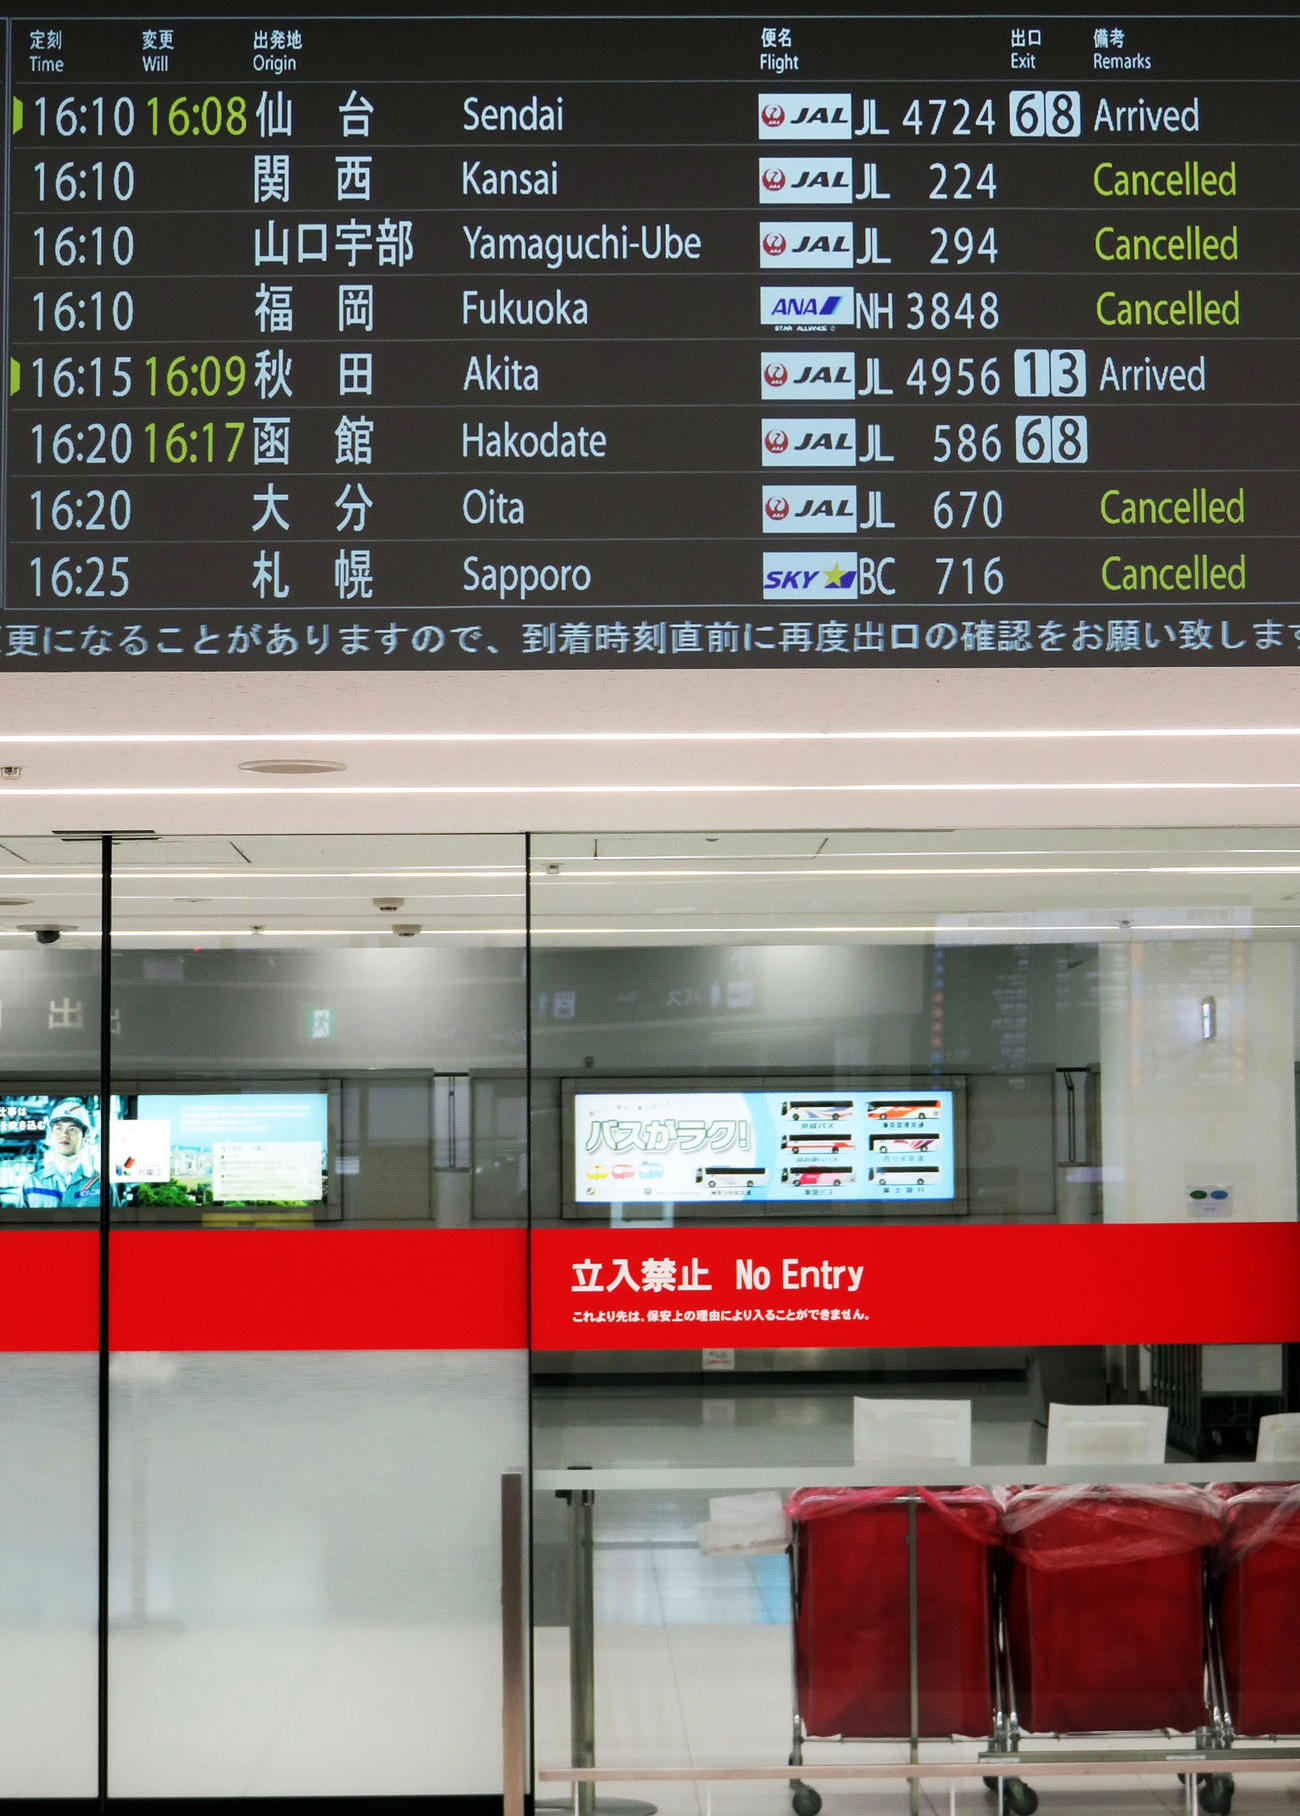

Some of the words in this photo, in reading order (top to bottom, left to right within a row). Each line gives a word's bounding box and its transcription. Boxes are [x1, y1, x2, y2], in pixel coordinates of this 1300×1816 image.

[30, 30, 61, 49] 定刻
[143, 30, 174, 49] 変更
[254, 30, 302, 49] 出発地
[762, 28, 791, 47] 便名
[1012, 29, 1041, 47] 出口
[1094, 28, 1124, 48] 備考
[30, 56, 63, 72] Time
[143, 56, 168, 71] Will
[254, 55, 296, 74] Origin
[761, 54, 798, 73] Flight
[1011, 53, 1035, 68] Exit
[1094, 53, 1151, 69] Remarks
[36, 97, 134, 136] 16:10
[148, 96, 246, 135] 16:08
[464, 96, 562, 130] Sendai
[791, 108, 848, 123] JAL
[855, 99, 889, 135] JL
[903, 99, 995, 134] 4724
[1094, 98, 1198, 131] Arrived
[35, 162, 134, 201] 16:10
[463, 161, 557, 194] Kansai
[791, 172, 849, 188] JAL
[856, 163, 890, 199] JL
[930, 163, 996, 199] 224
[1094, 161, 1236, 196] Cancelled
[34, 226, 133, 265] 16:10
[255, 218, 413, 267] 山口宇部
[463, 224, 701, 269] Yamaguchi-Ube
[792, 236, 850, 252] JAL
[857, 228, 891, 264] JL
[931, 227, 998, 264] 294
[1096, 226, 1237, 260] Cancelled
[34, 291, 133, 331] 16:10
[464, 289, 587, 324] Fukuoka
[771, 297, 817, 315] ANA
[856, 293, 893, 328] NH
[907, 292, 998, 329] 3848
[1097, 291, 1239, 325] Cancelled
[33, 357, 131, 397] 16:15
[146, 356, 245, 396] 16:09
[464, 354, 538, 390] Akita
[794, 367, 851, 383] JAL
[858, 358, 893, 395] JL
[907, 357, 1000, 395] 4956
[1100, 356, 1205, 391] Arrived
[32, 423, 131, 463] 16:20
[145, 423, 244, 463] 16:17
[463, 421, 606, 457] Hakodate
[794, 433, 852, 450] JAL
[859, 425, 894, 462] JL
[934, 424, 1001, 462] 586
[31, 490, 130, 530] 16:20
[463, 489, 523, 523] Oita
[795, 500, 853, 517] JAL
[860, 491, 895, 528] JL
[934, 490, 1002, 529] 670
[1101, 488, 1244, 524] Cancelled
[31, 557, 128, 597] 16:25
[464, 556, 591, 599] Sapporo
[764, 570, 818, 589] SKY
[860, 557, 895, 595] BC
[936, 557, 1003, 594] 716
[1102, 554, 1245, 590] Cancelled
[0, 620, 1300, 655] 更になることがありますので、到着時刻直前に再度出口の確認をお願い致しま
[572, 1258, 712, 1292] 立入禁止
[737, 1259, 770, 1290] No
[783, 1259, 863, 1291] Entry
[573, 1309, 869, 1322] これより先は、保安上の理由により入ることができません。
